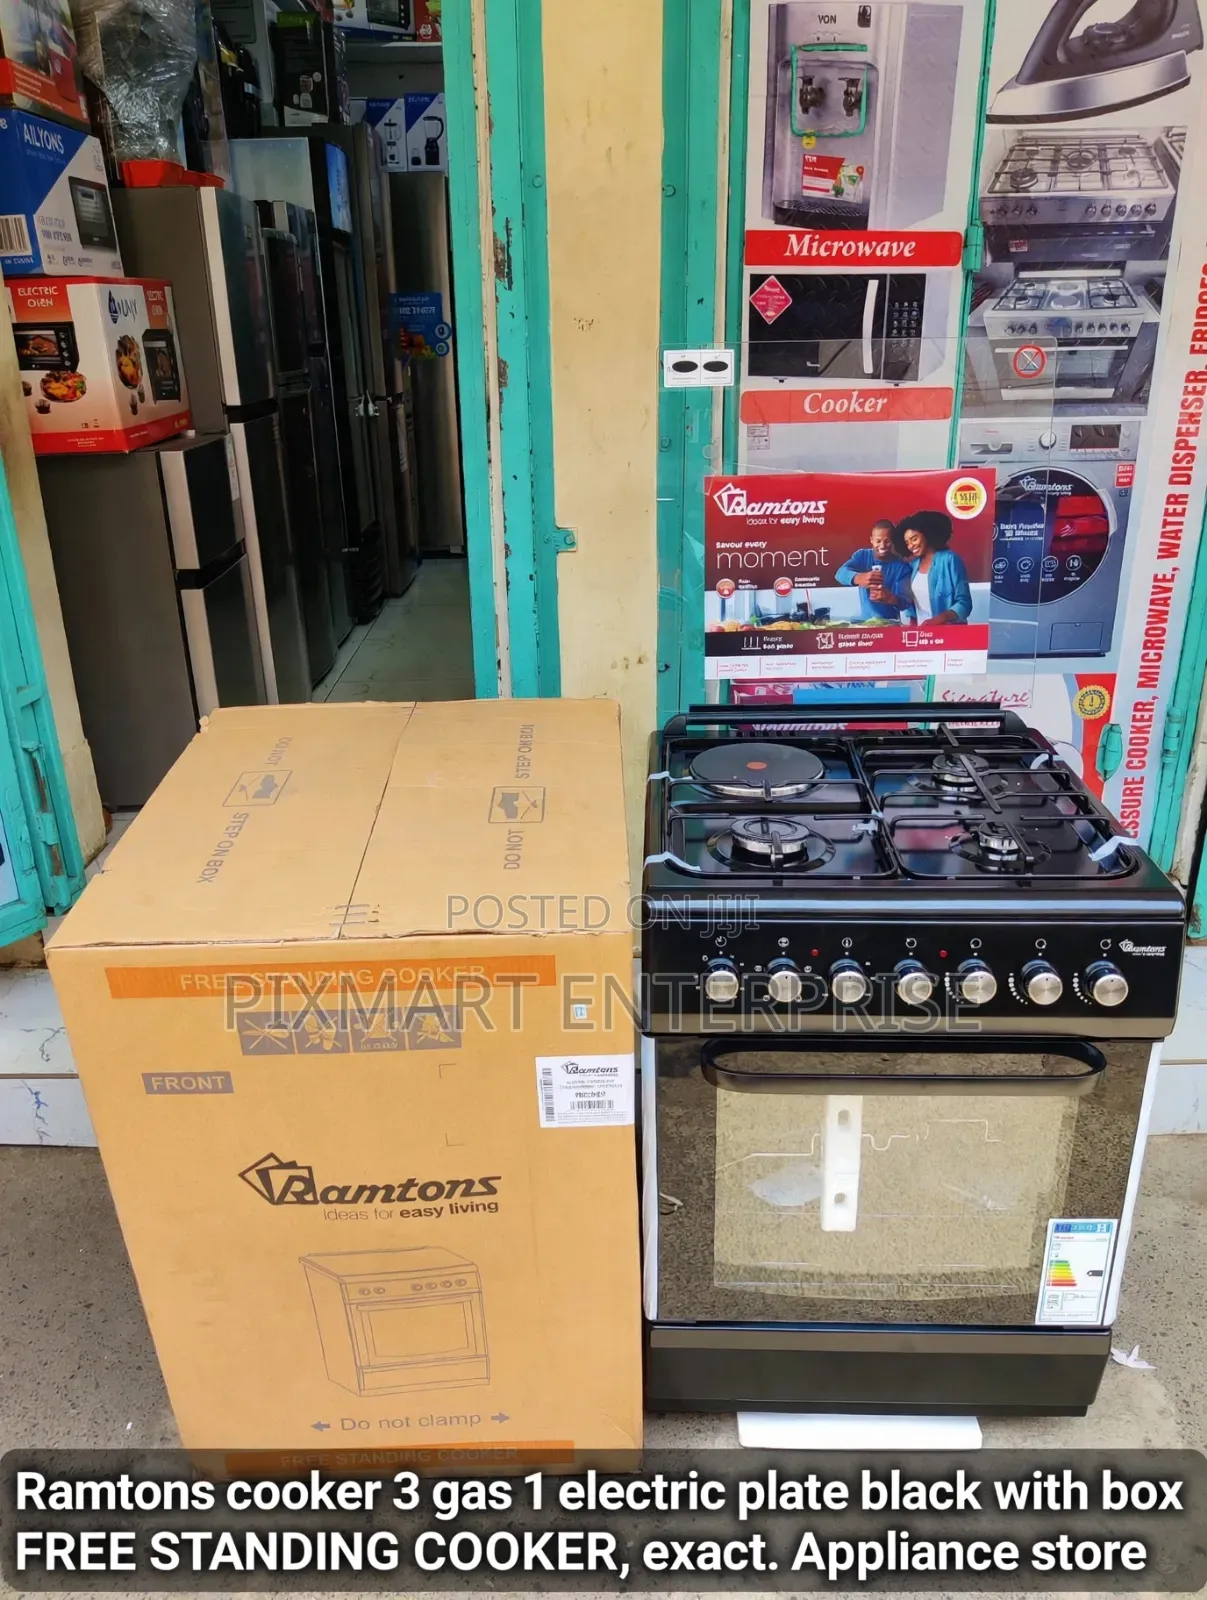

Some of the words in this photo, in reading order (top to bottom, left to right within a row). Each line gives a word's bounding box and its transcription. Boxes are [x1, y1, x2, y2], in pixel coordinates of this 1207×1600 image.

[818, 14, 837, 25] VON
[23, 122, 65, 155] AILYONS
[783, 233, 916, 257] Microwave
[18, 286, 59, 297] ELECTRIC
[803, 391, 888, 414] Cooker
[723, 489, 828, 516] Ramtons
[780, 516, 801, 526] easy
[802, 515, 825, 525] living
[1157, 492, 1190, 560] WATER
[717, 546, 829, 569] moment
[1136, 566, 1181, 690] MICROWAVE,
[518, 738, 532, 753] ON
[1125, 696, 1160, 773] COOKER,
[515, 755, 531, 779] STEP
[1119, 776, 1145, 839] SSURE
[223, 812, 250, 838] STEP
[211, 840, 234, 857] ON
[505, 829, 524, 851] NOT
[196, 859, 224, 883] BOX
[503, 853, 521, 870] DO
[180, 974, 245, 990] FREE
[252, 968, 374, 987] STANDING
[383, 965, 486, 985] COOKER
[566, 1063, 618, 1075] Ramtons
[151, 1075, 225, 1091] FRONT
[260, 1166, 502, 1205] Ramtons
[323, 1208, 369, 1221] Ideas
[373, 1208, 394, 1220] for
[399, 1205, 444, 1219] easy
[449, 1201, 499, 1215] living
[340, 1417, 370, 1431] Do
[378, 1416, 411, 1429] not
[418, 1413, 482, 1429] clamp
[280, 1454, 329, 1469] FREE
[336, 1449, 431, 1466] STANDING
[437, 1446, 520, 1462] COOKER
